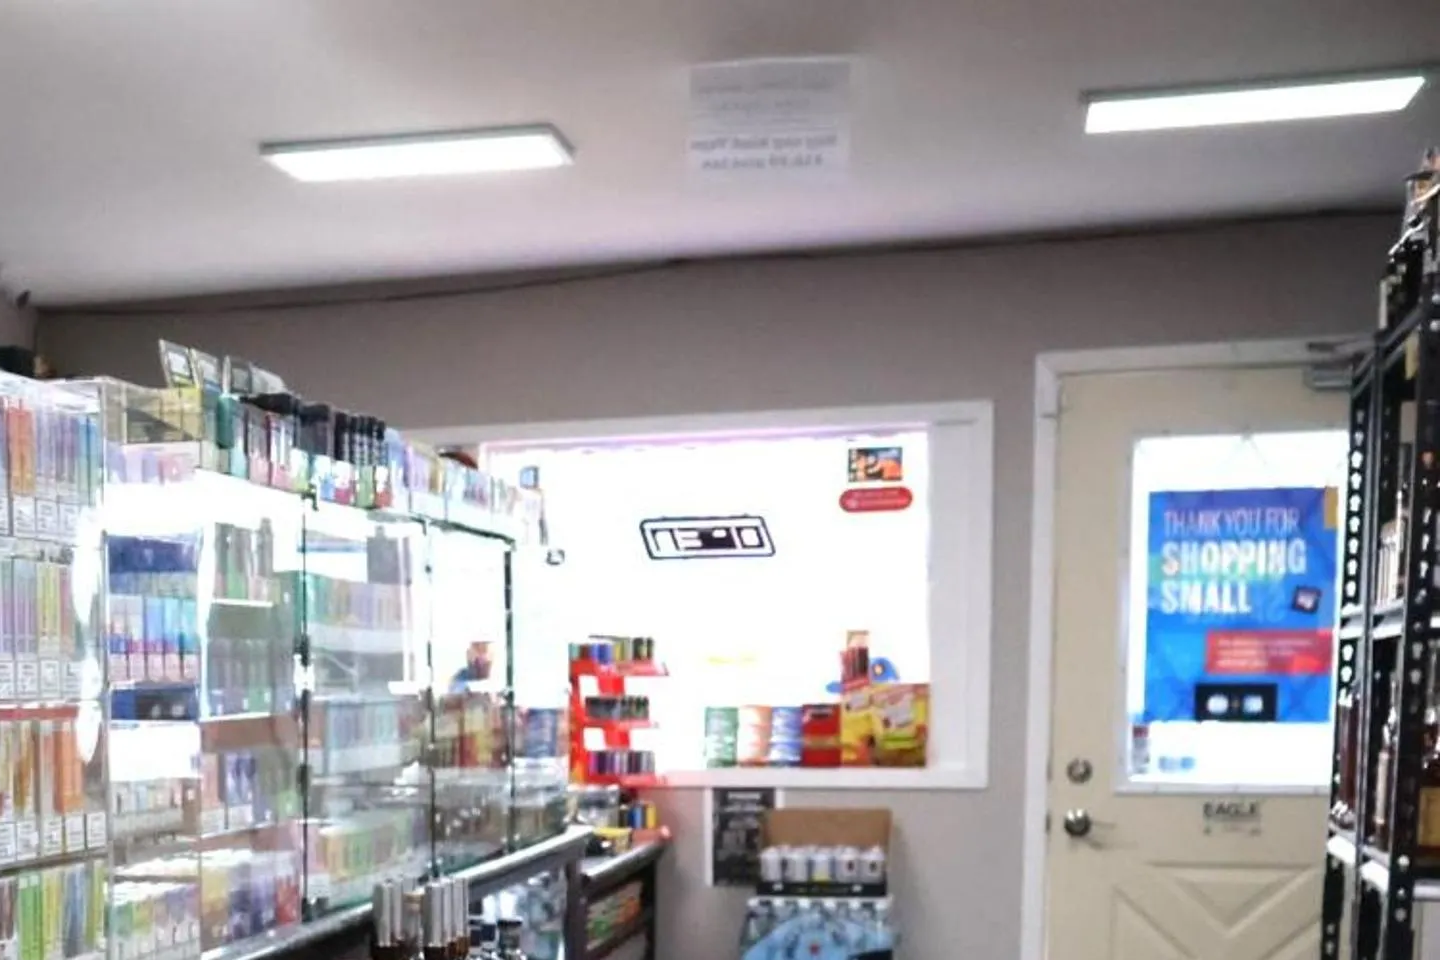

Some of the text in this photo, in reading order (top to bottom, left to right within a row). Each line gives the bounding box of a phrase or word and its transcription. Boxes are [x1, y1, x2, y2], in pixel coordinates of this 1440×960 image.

[1163, 506, 1301, 537] THANK YOU FOR
[1161, 538, 1307, 576] SHOPPING
[1161, 579, 1252, 615] SMALL
